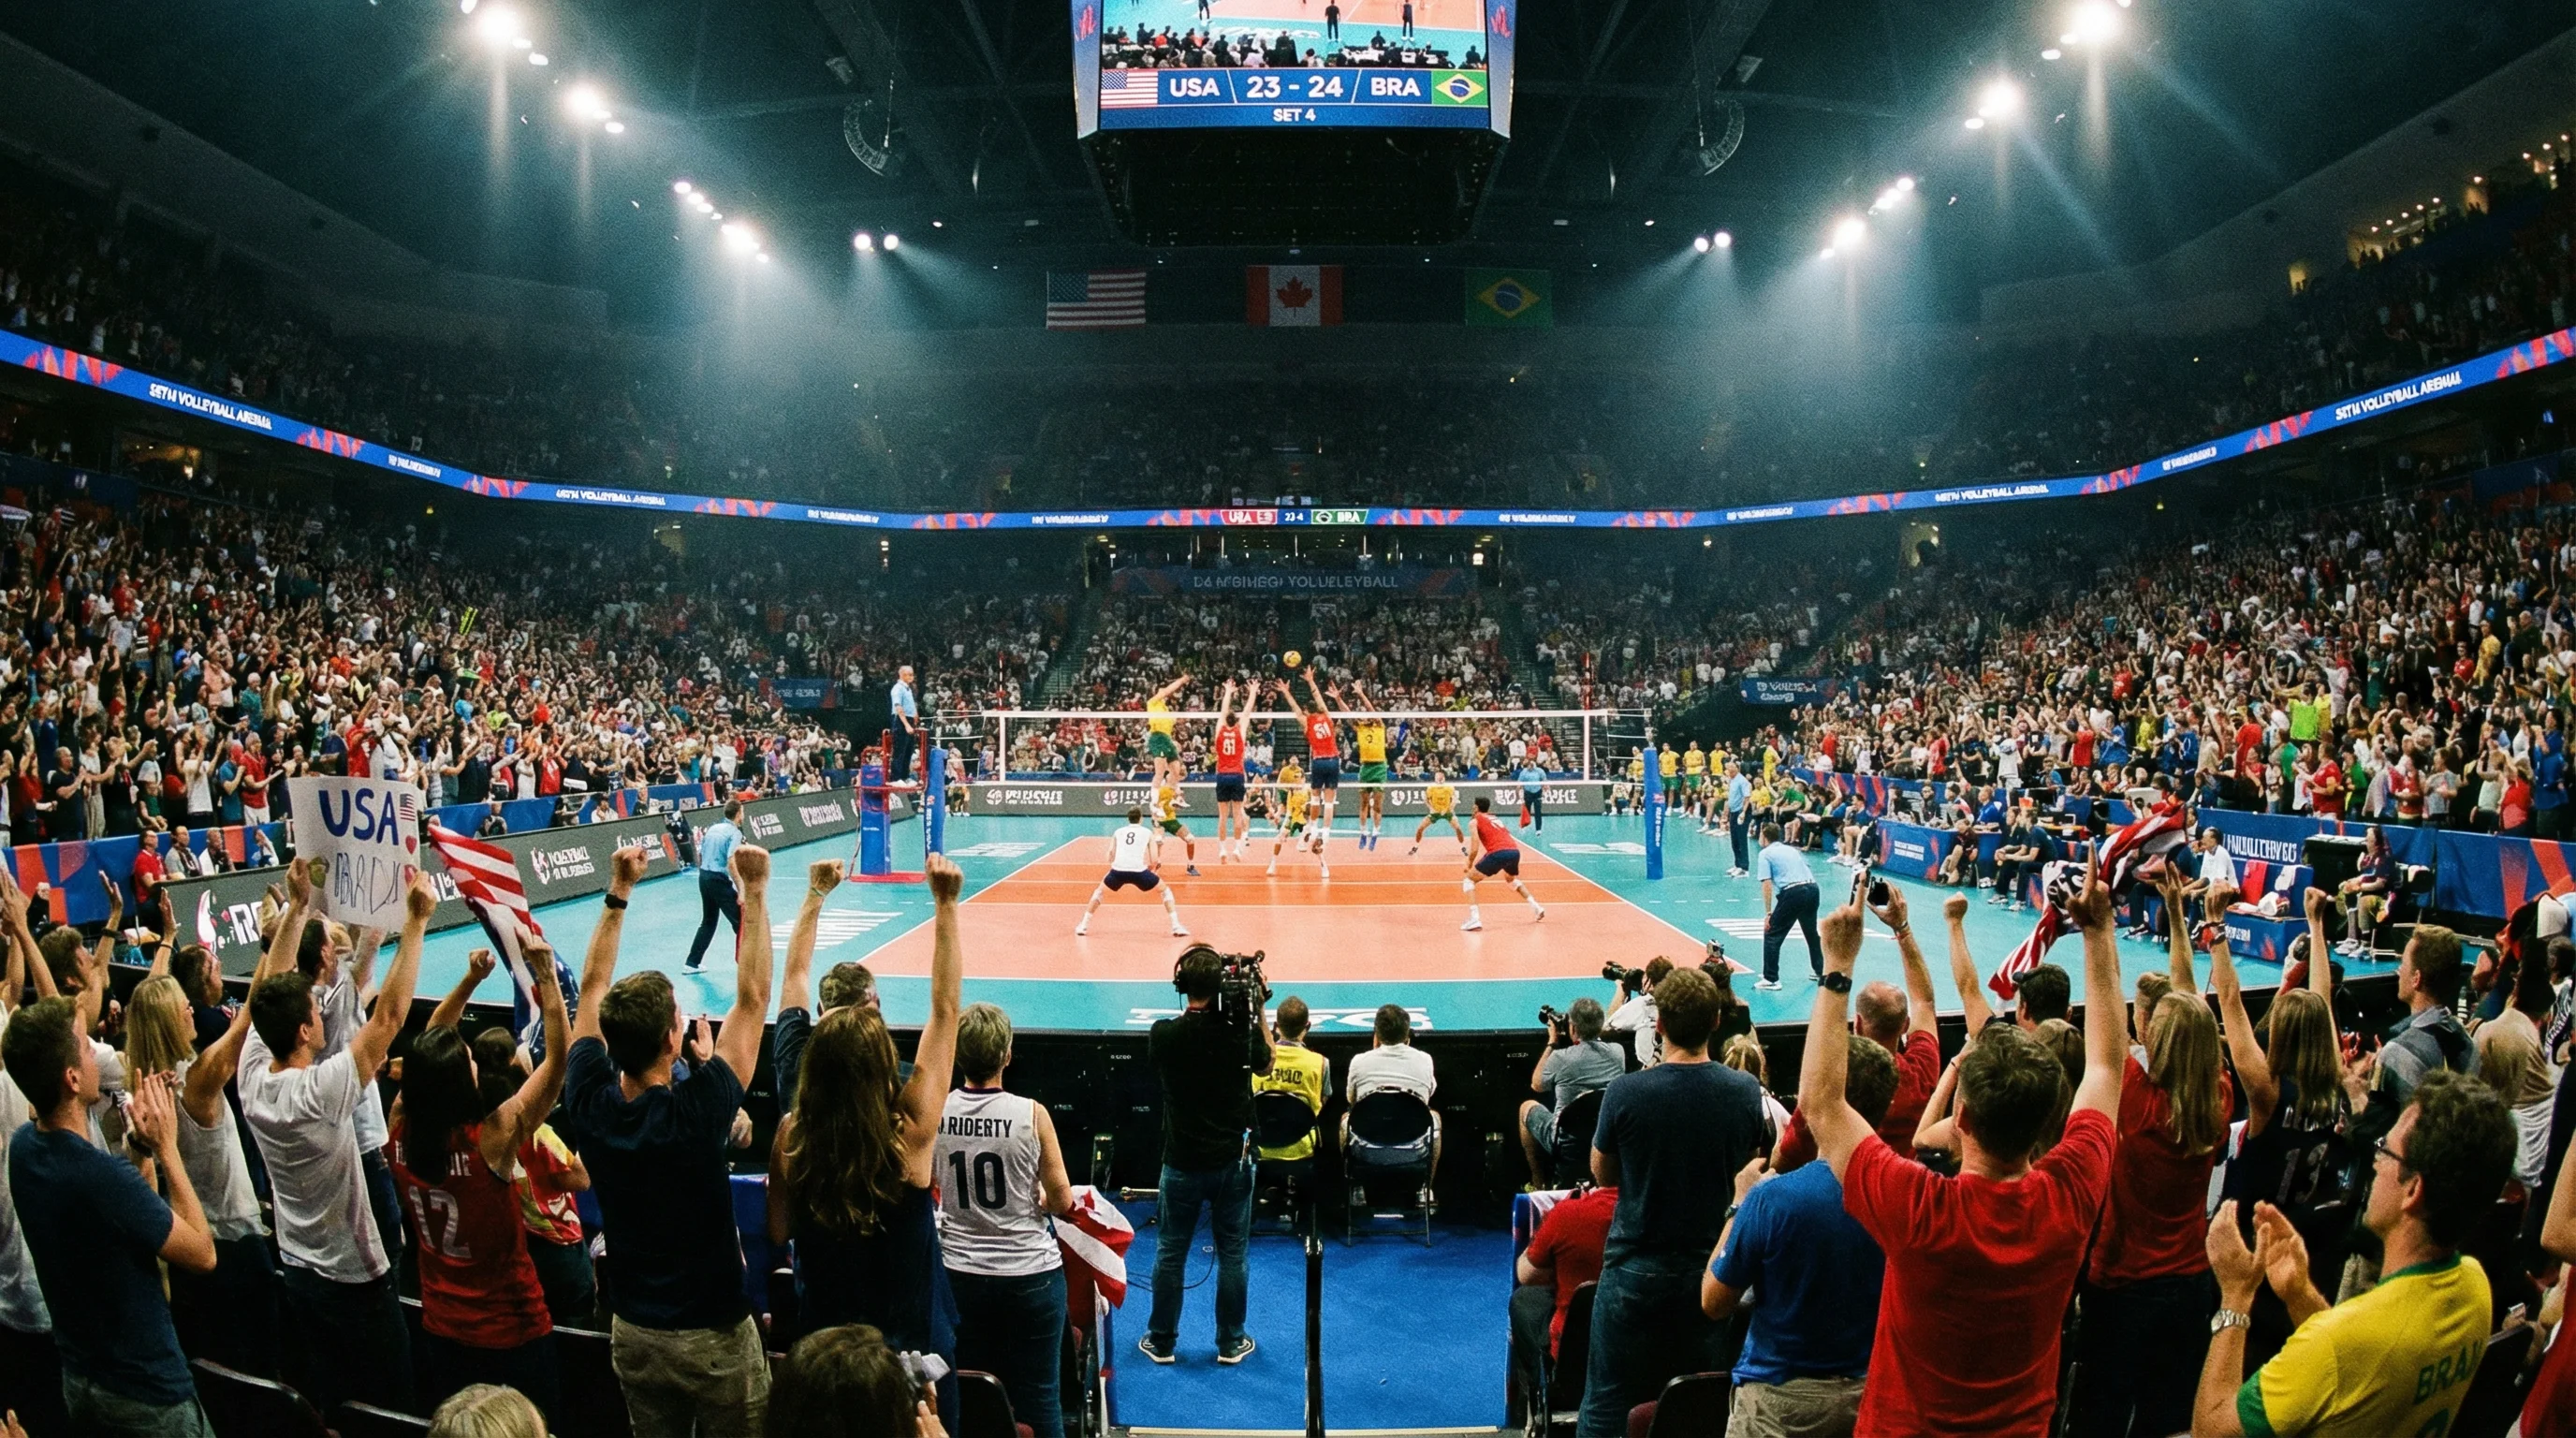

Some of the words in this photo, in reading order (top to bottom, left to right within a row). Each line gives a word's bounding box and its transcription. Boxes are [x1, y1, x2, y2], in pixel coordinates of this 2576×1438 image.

[1170, 78, 1221, 97] USA
[1247, 76, 1281, 98] 23
[1309, 75, 1344, 98] 24
[1371, 77, 1422, 97] BRA
[1273, 109, 1303, 122] SET
[1305, 109, 1317, 122] 4
[319, 787, 400, 845] USA
[1125, 831, 1135, 845] 8
[947, 1116, 1013, 1138] RIDERTY
[948, 1150, 1007, 1210] 10
[409, 1185, 473, 1259] 12
